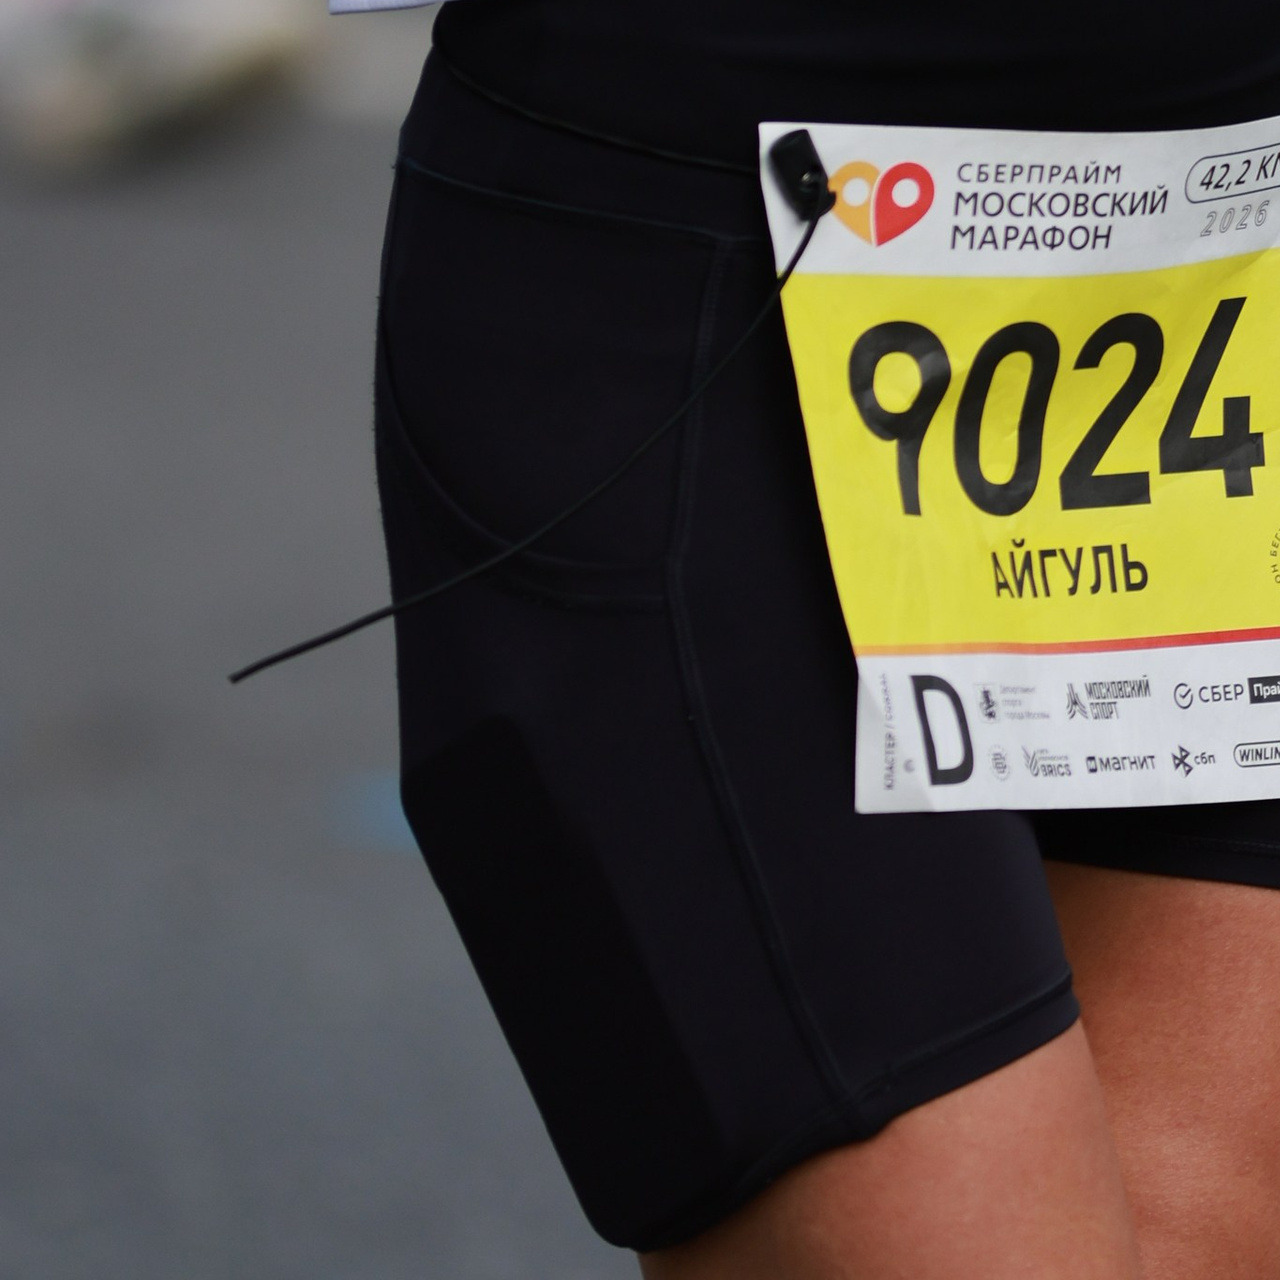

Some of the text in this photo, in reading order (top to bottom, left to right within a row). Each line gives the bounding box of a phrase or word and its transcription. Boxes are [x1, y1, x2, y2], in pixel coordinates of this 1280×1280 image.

[957, 160, 1122, 184] СБЕРПРАЙМ
[1199, 159, 1251, 192] 42,2
[953, 184, 1169, 217] МОСКОВСКИЙ
[1200, 200, 1271, 238] 2026
[950, 225, 1113, 251] МАРАФОН
[848, 296, 1266, 517] 9024
[991, 537, 1149, 599] АЙГУЛЬ
[1084, 674, 1152, 700] МОСКОВСКИЙ
[1198, 683, 1245, 703] СБЕР
[1089, 701, 1120, 720] СПОРТ
[909, 674, 974, 786] D
[1040, 763, 1072, 778] BRICS
[1193, 751, 1216, 766] сбп
